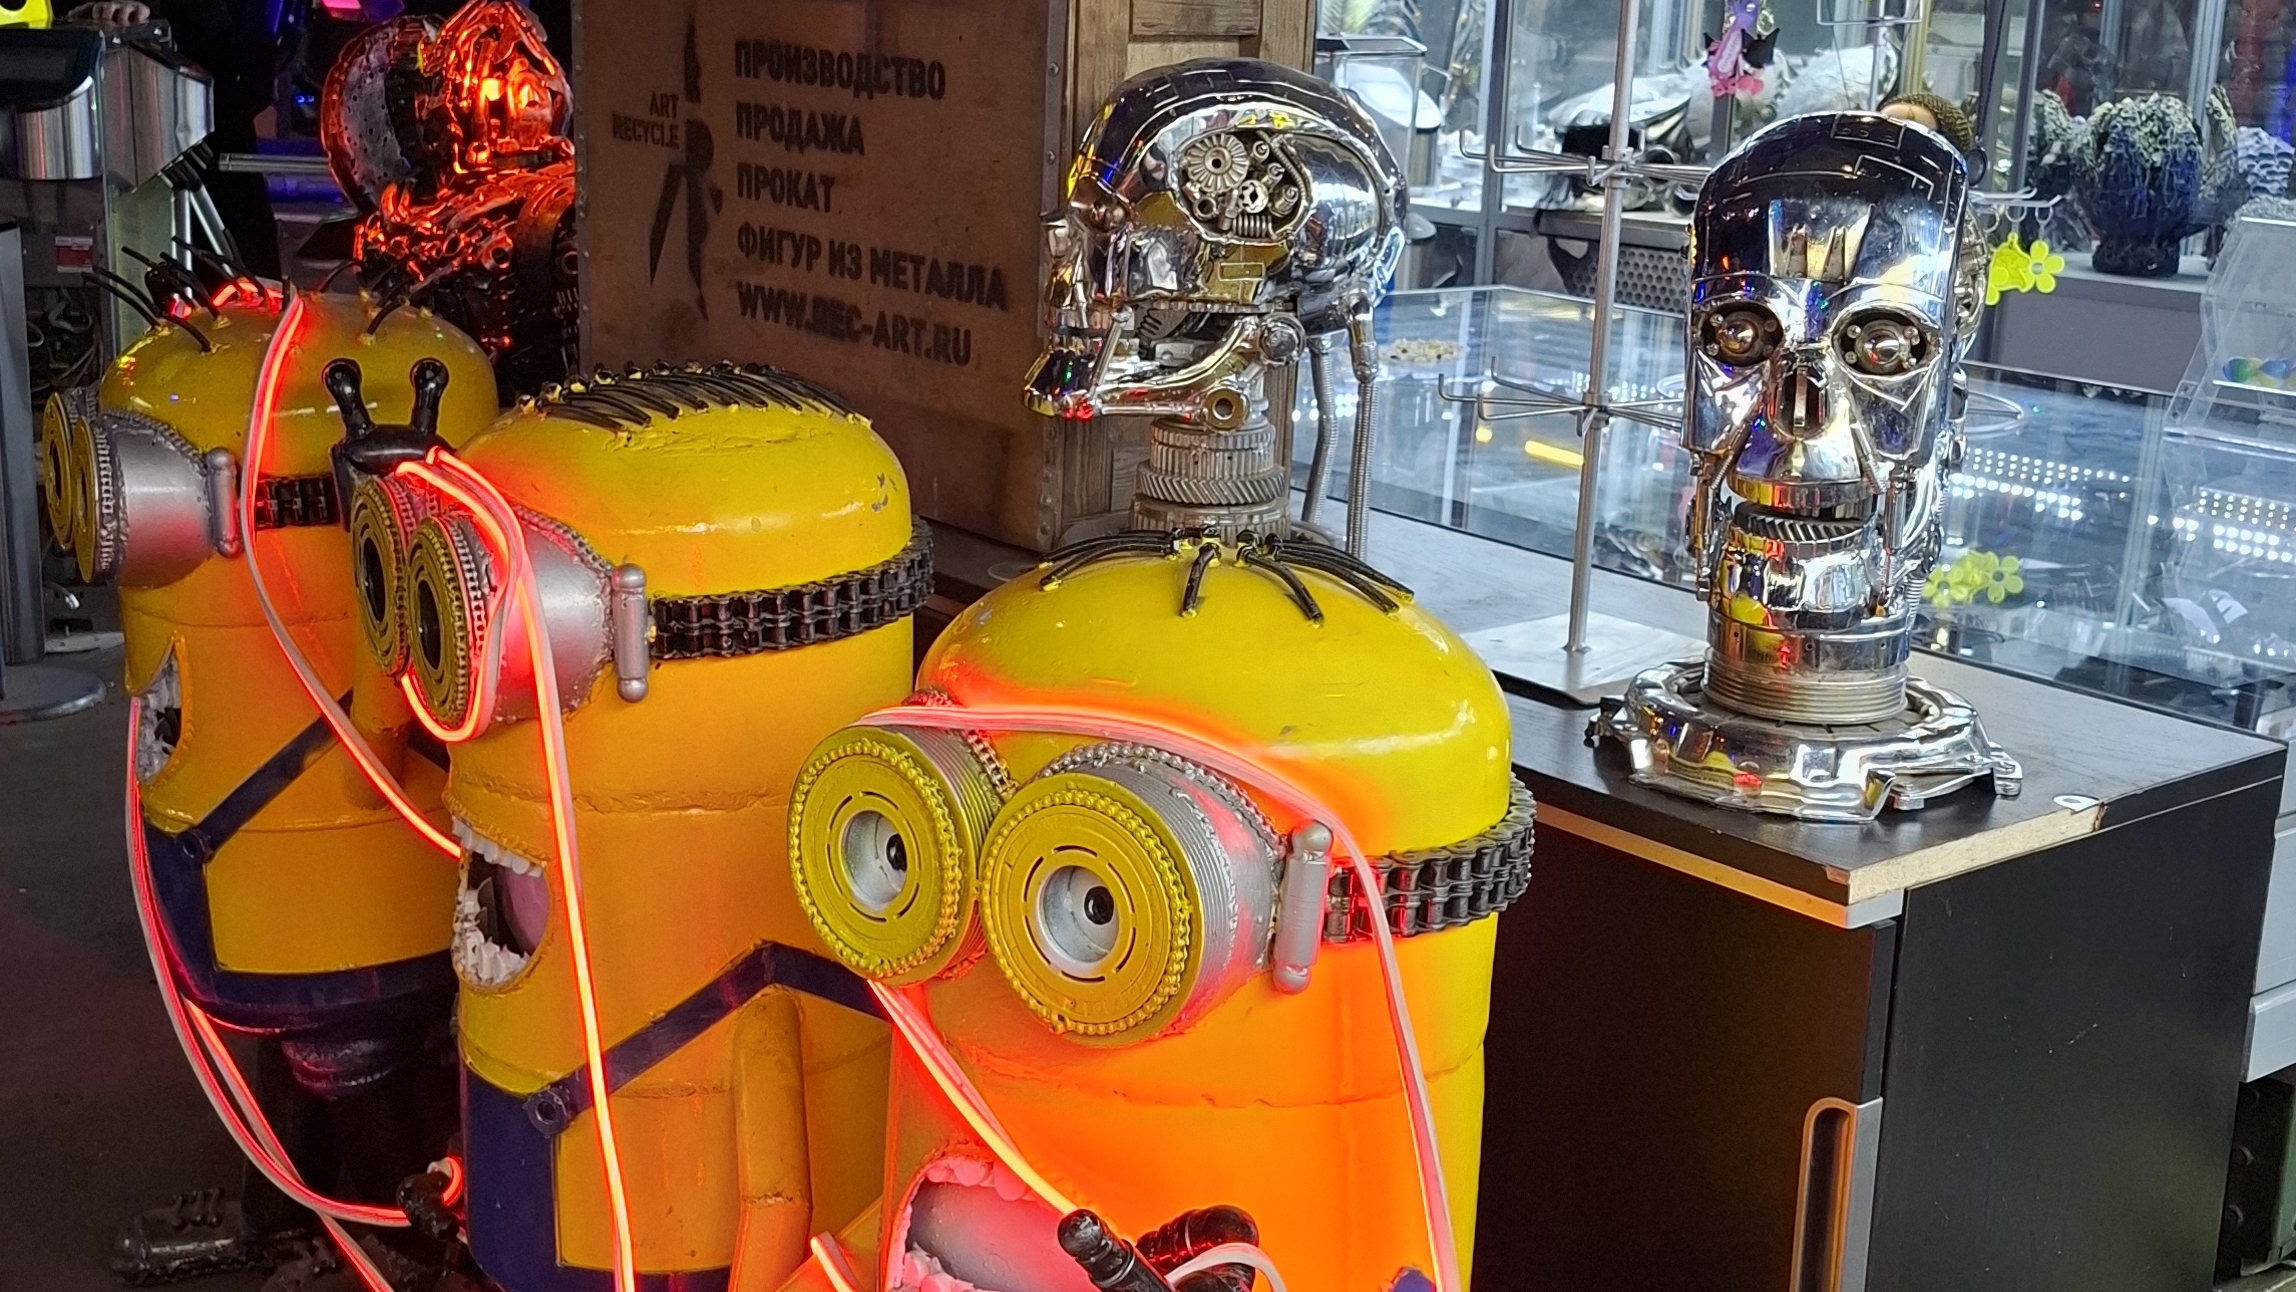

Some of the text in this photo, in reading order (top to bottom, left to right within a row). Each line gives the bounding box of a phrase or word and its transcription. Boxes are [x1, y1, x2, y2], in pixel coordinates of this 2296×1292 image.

[735, 39, 946, 100] ПРОИЗВОДСТВО
[649, 92, 679, 119] ART
[735, 100, 865, 156] ПРОДАЖА
[737, 162, 836, 213] ПРОКАТ
[737, 222, 1007, 310] ФИГУР ИЗ МЕТАЛЛА
